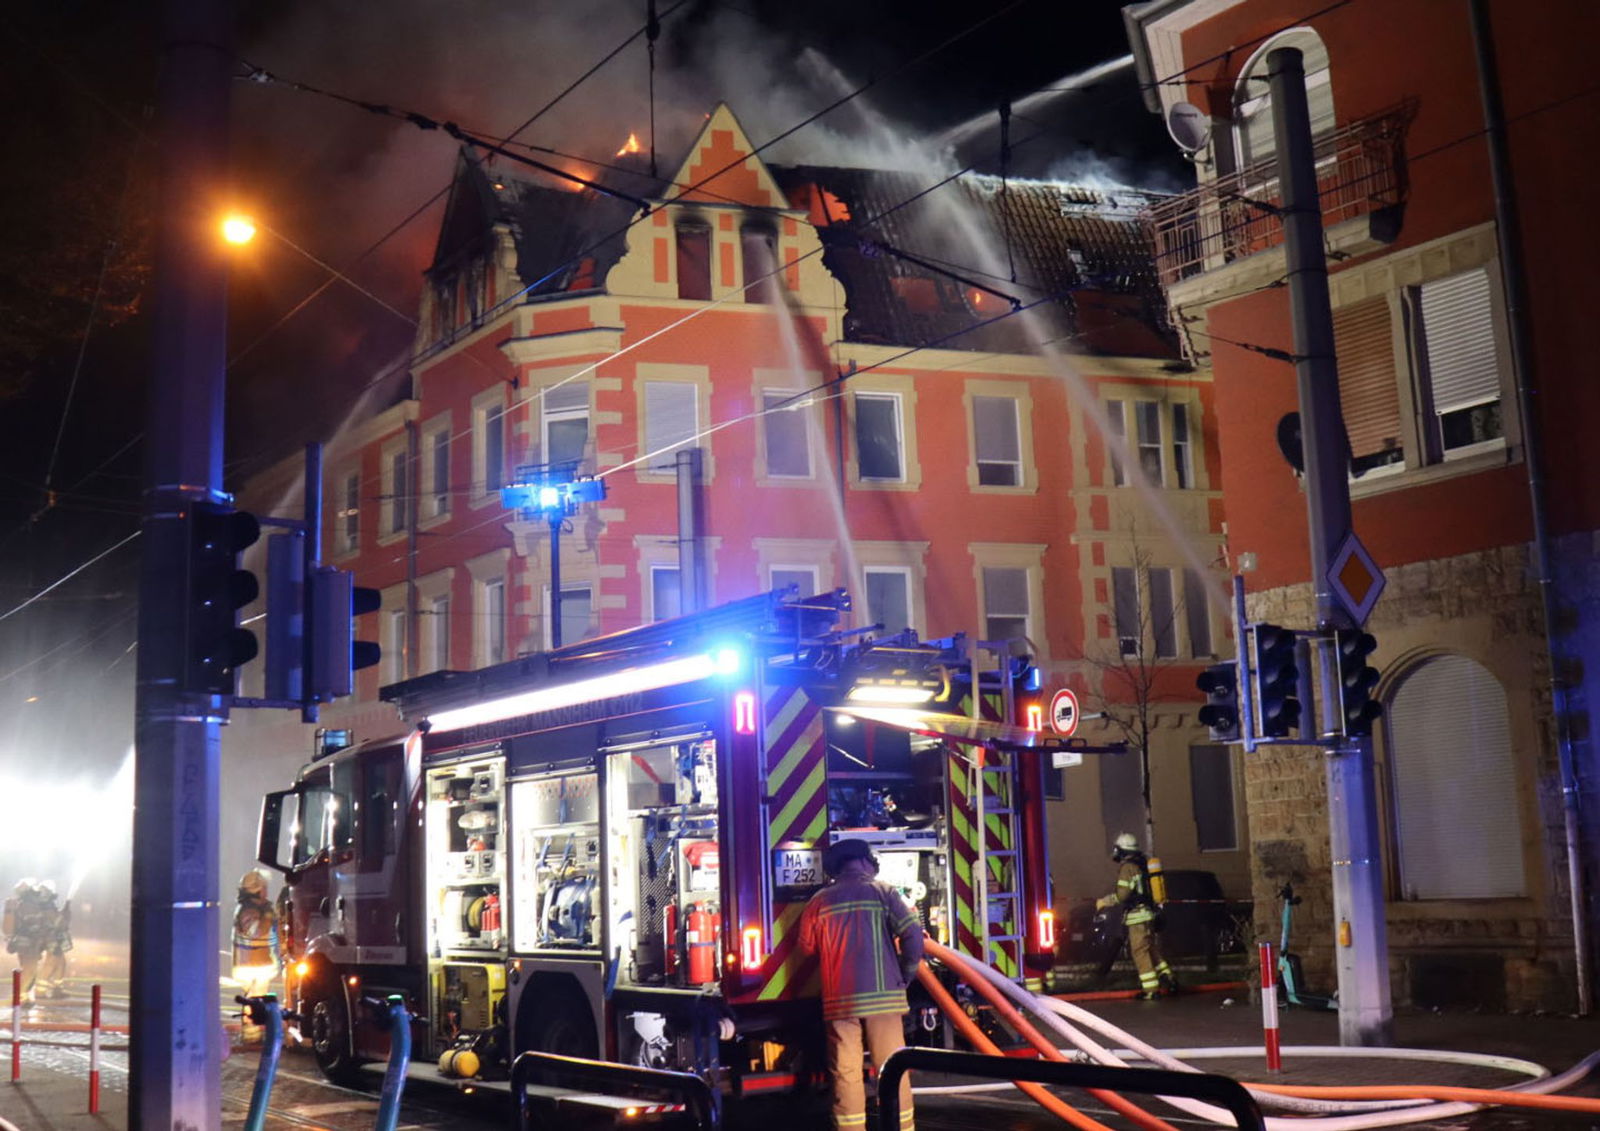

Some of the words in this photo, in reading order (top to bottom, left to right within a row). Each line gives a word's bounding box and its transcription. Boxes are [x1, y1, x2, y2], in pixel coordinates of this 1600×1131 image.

[786, 854, 802, 867] MA
[783, 869, 790, 883] F
[793, 868, 816, 883] 252
